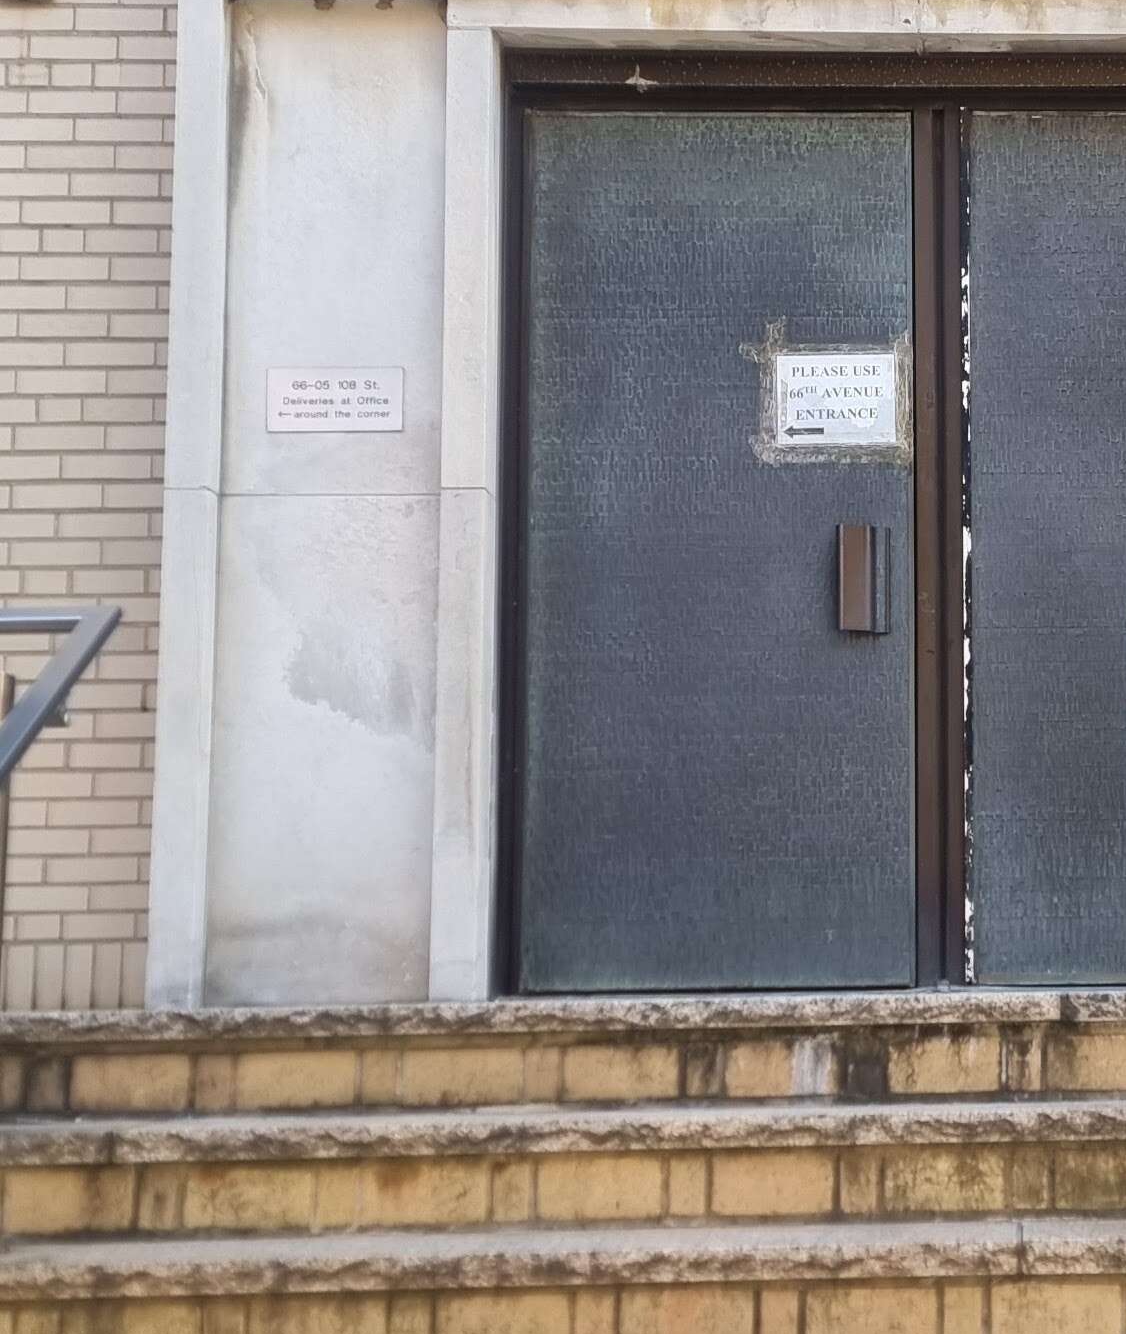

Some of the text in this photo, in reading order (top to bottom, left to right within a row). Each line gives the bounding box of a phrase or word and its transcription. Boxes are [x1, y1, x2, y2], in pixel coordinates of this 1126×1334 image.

[792, 366, 880, 377] PLEASE USE
[292, 380, 329, 390] 66-05
[364, 380, 379, 389] St.
[790, 386, 883, 399] 66TH AVENUE
[283, 397, 389, 405] Deliveries at Office
[335, 410, 351, 418] the
[796, 408, 878, 420] ENTRANCE
